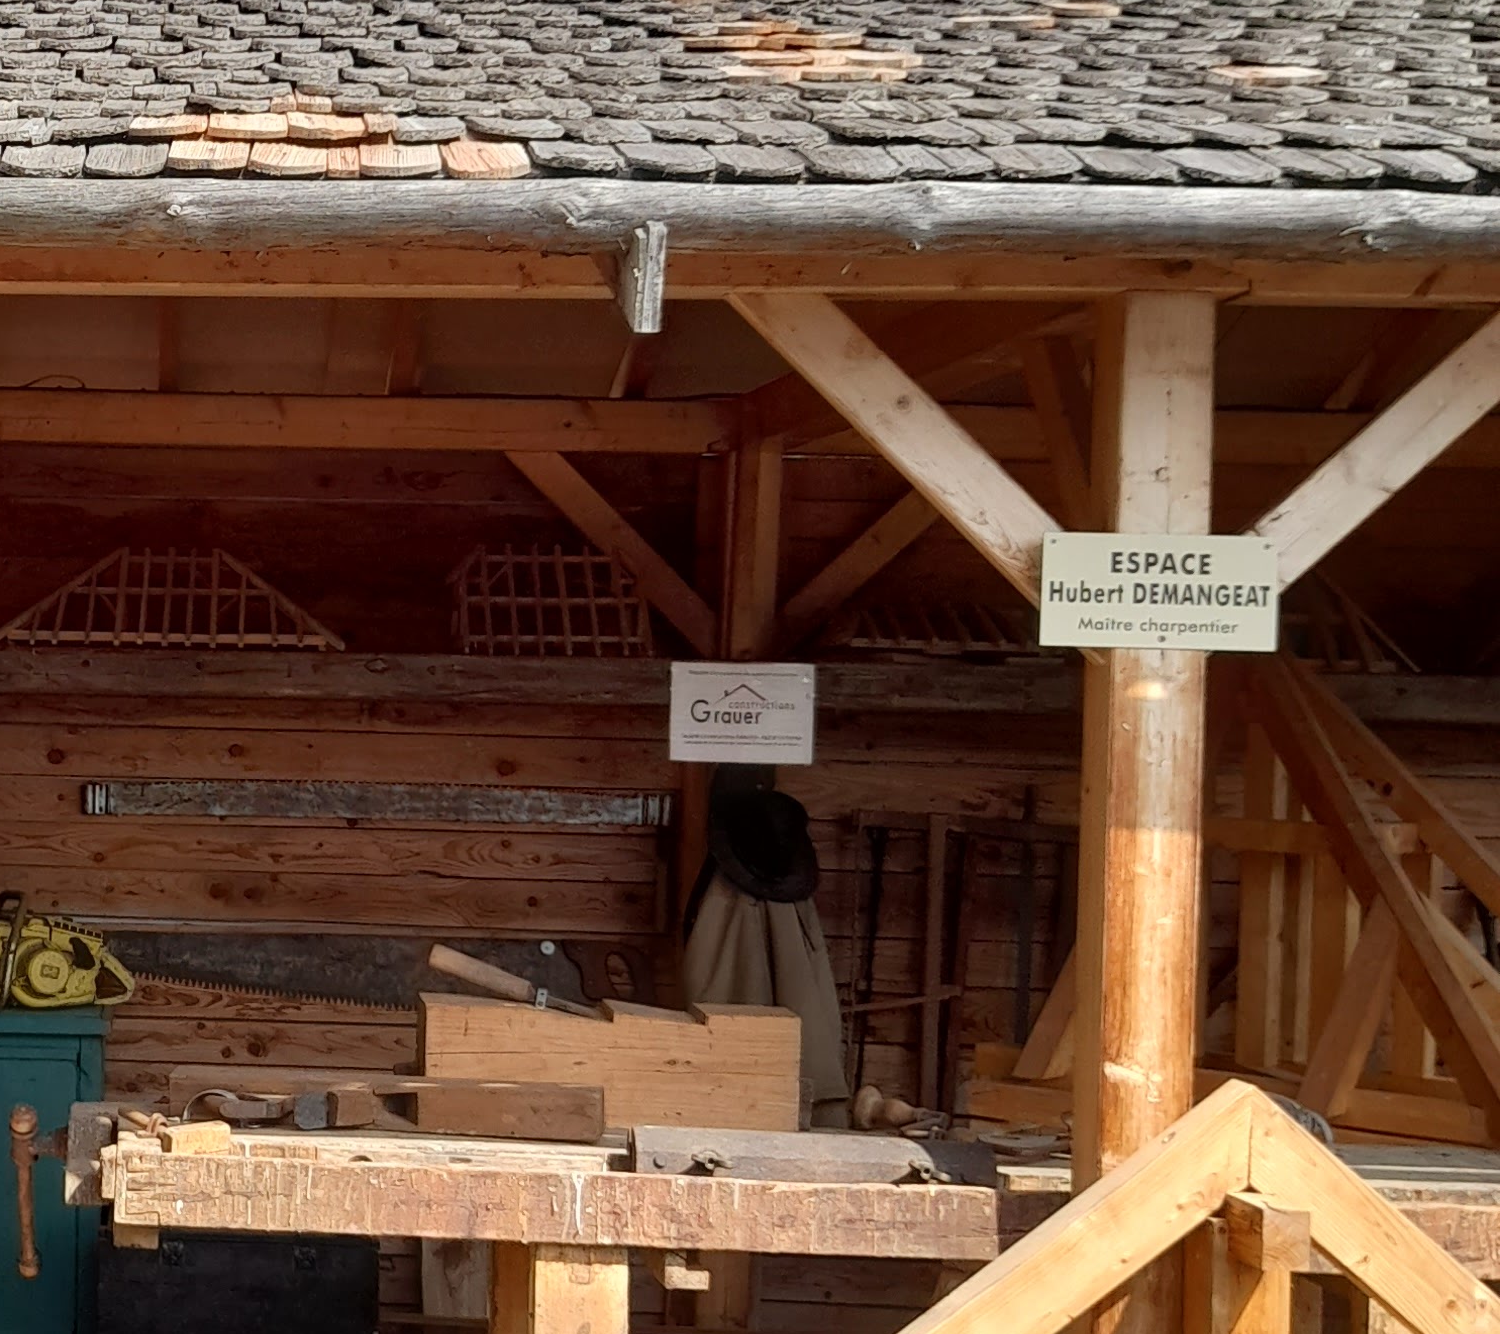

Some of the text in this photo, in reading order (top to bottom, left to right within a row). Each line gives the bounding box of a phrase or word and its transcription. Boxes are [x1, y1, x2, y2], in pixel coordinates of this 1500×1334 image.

[1110, 551, 1212, 576] ESPACE
[1049, 580, 1271, 608] Hubert DEMANGEAT
[1077, 616, 1240, 636] Maître charpentier
[690, 699, 763, 725] Grauer
